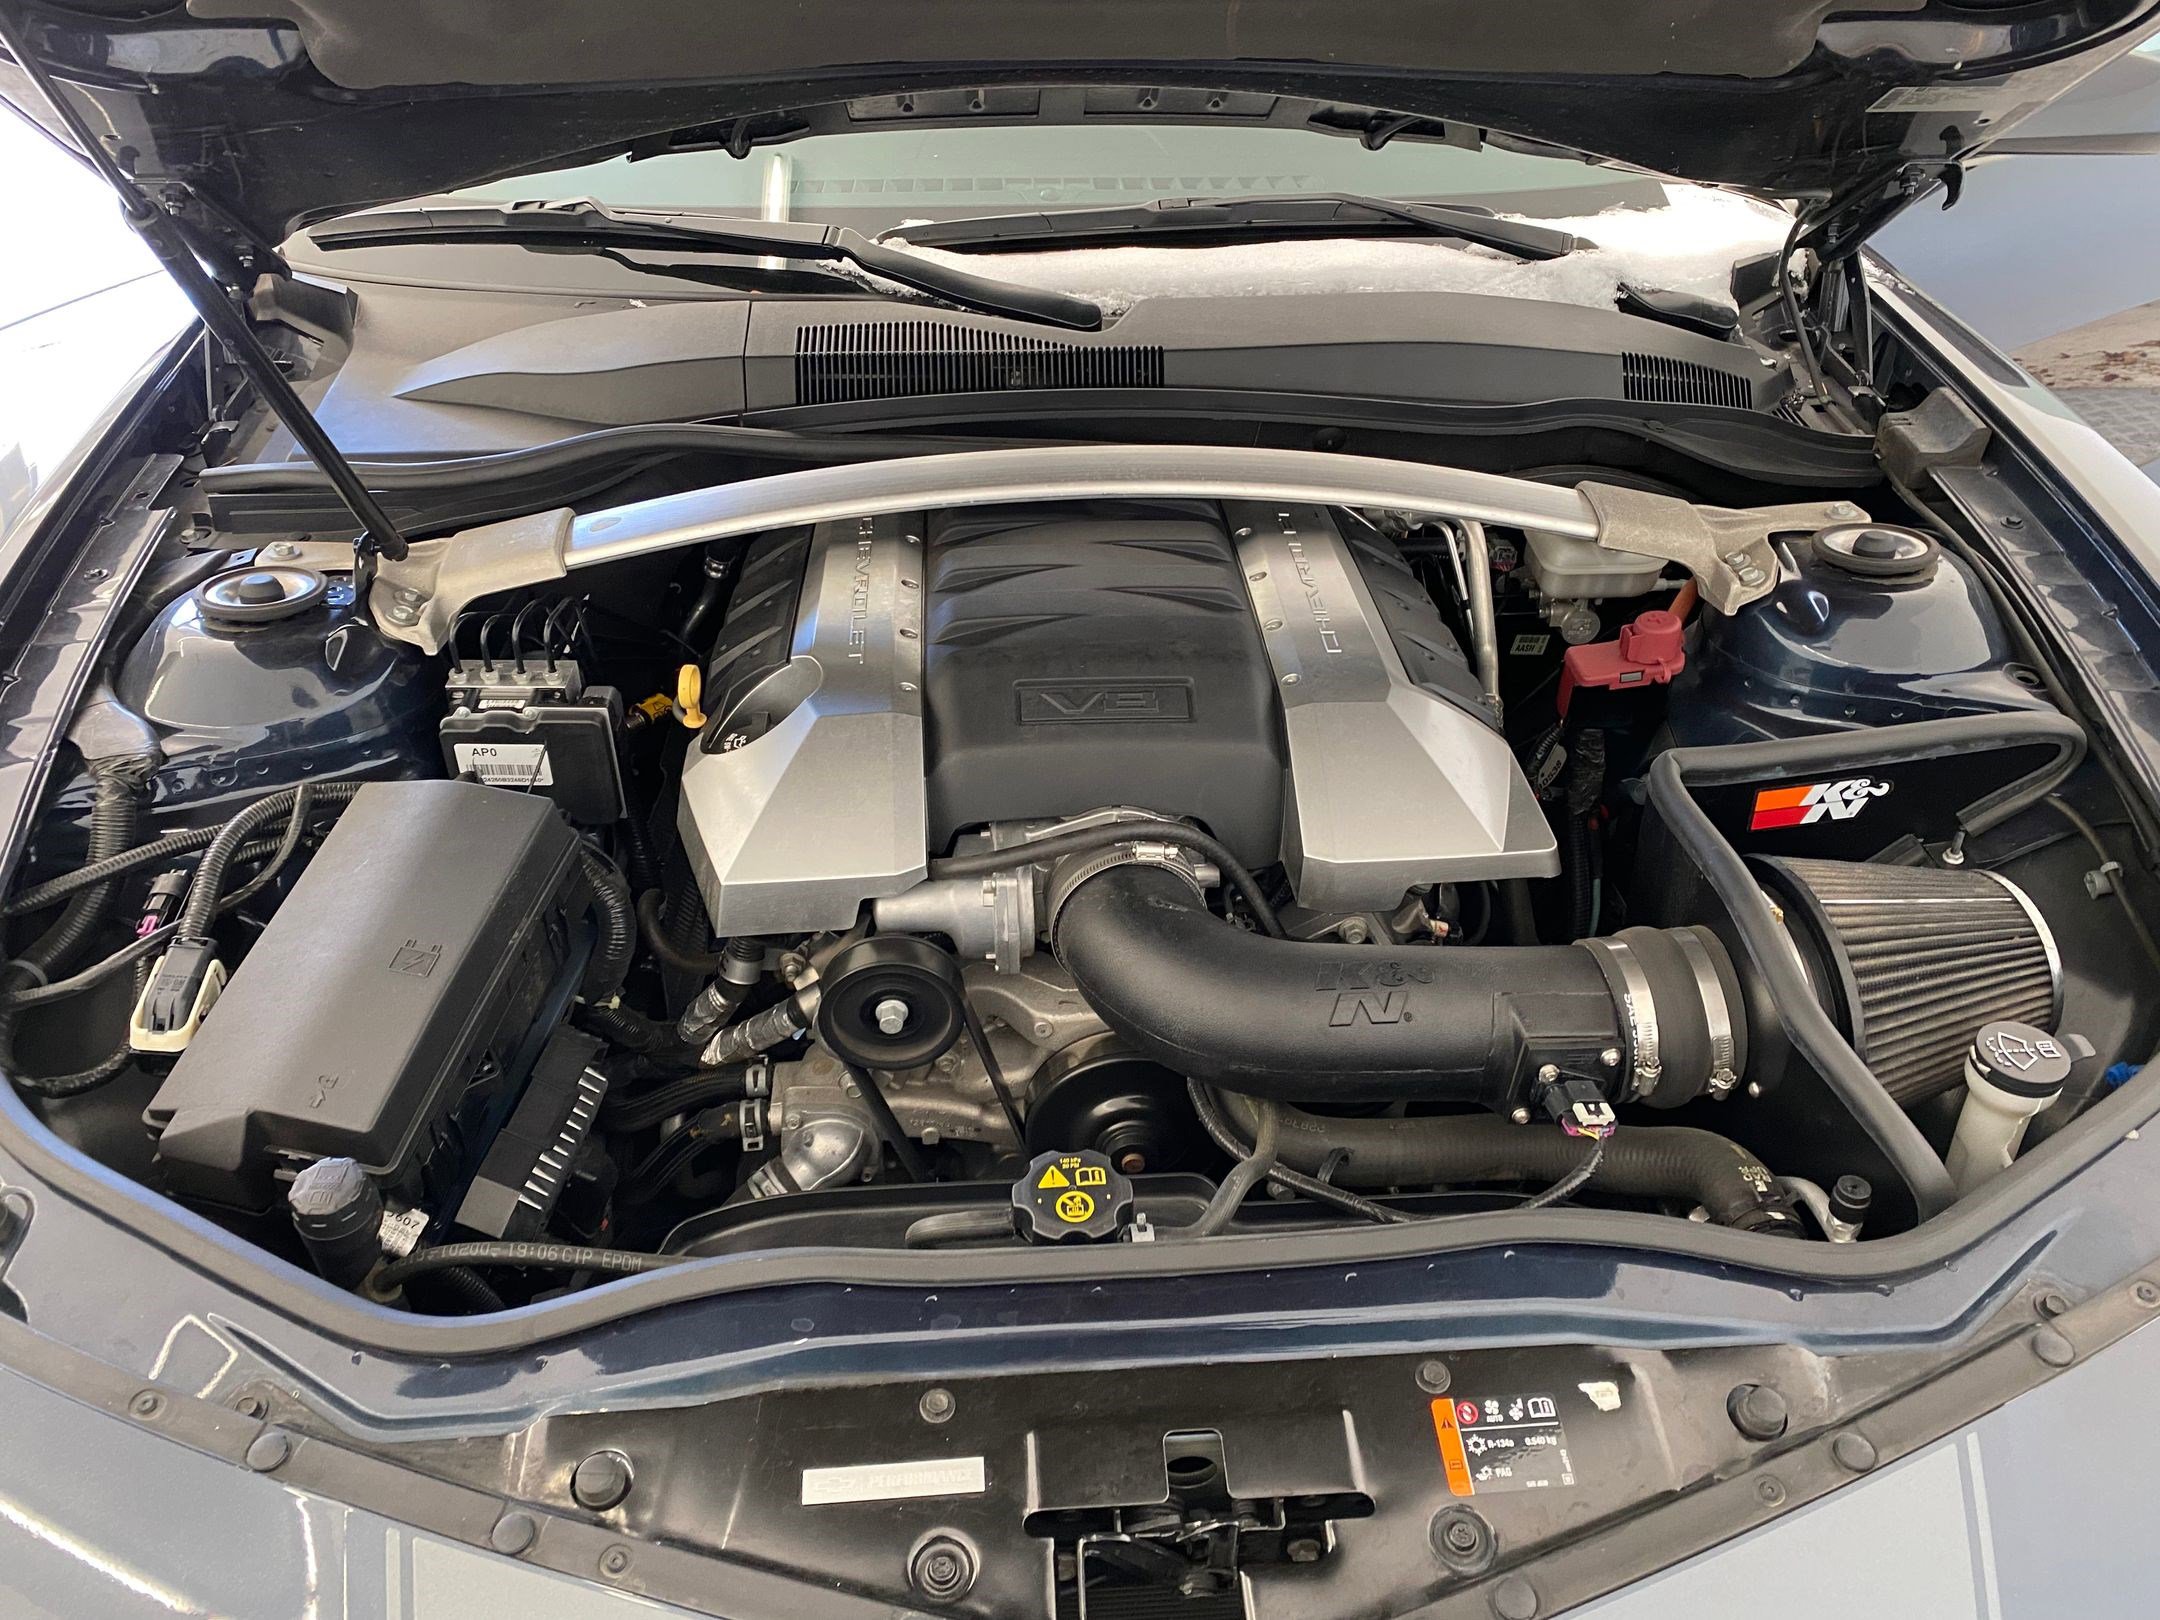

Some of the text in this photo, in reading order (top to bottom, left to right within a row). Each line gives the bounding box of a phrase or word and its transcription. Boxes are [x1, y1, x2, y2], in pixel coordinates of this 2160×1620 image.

[848, 517, 873, 665] CHEVROLET
[1278, 512, 1342, 653] CHEVROLET
[1039, 690, 1159, 715] V8
[602, 1251, 642, 1272] EPDM
